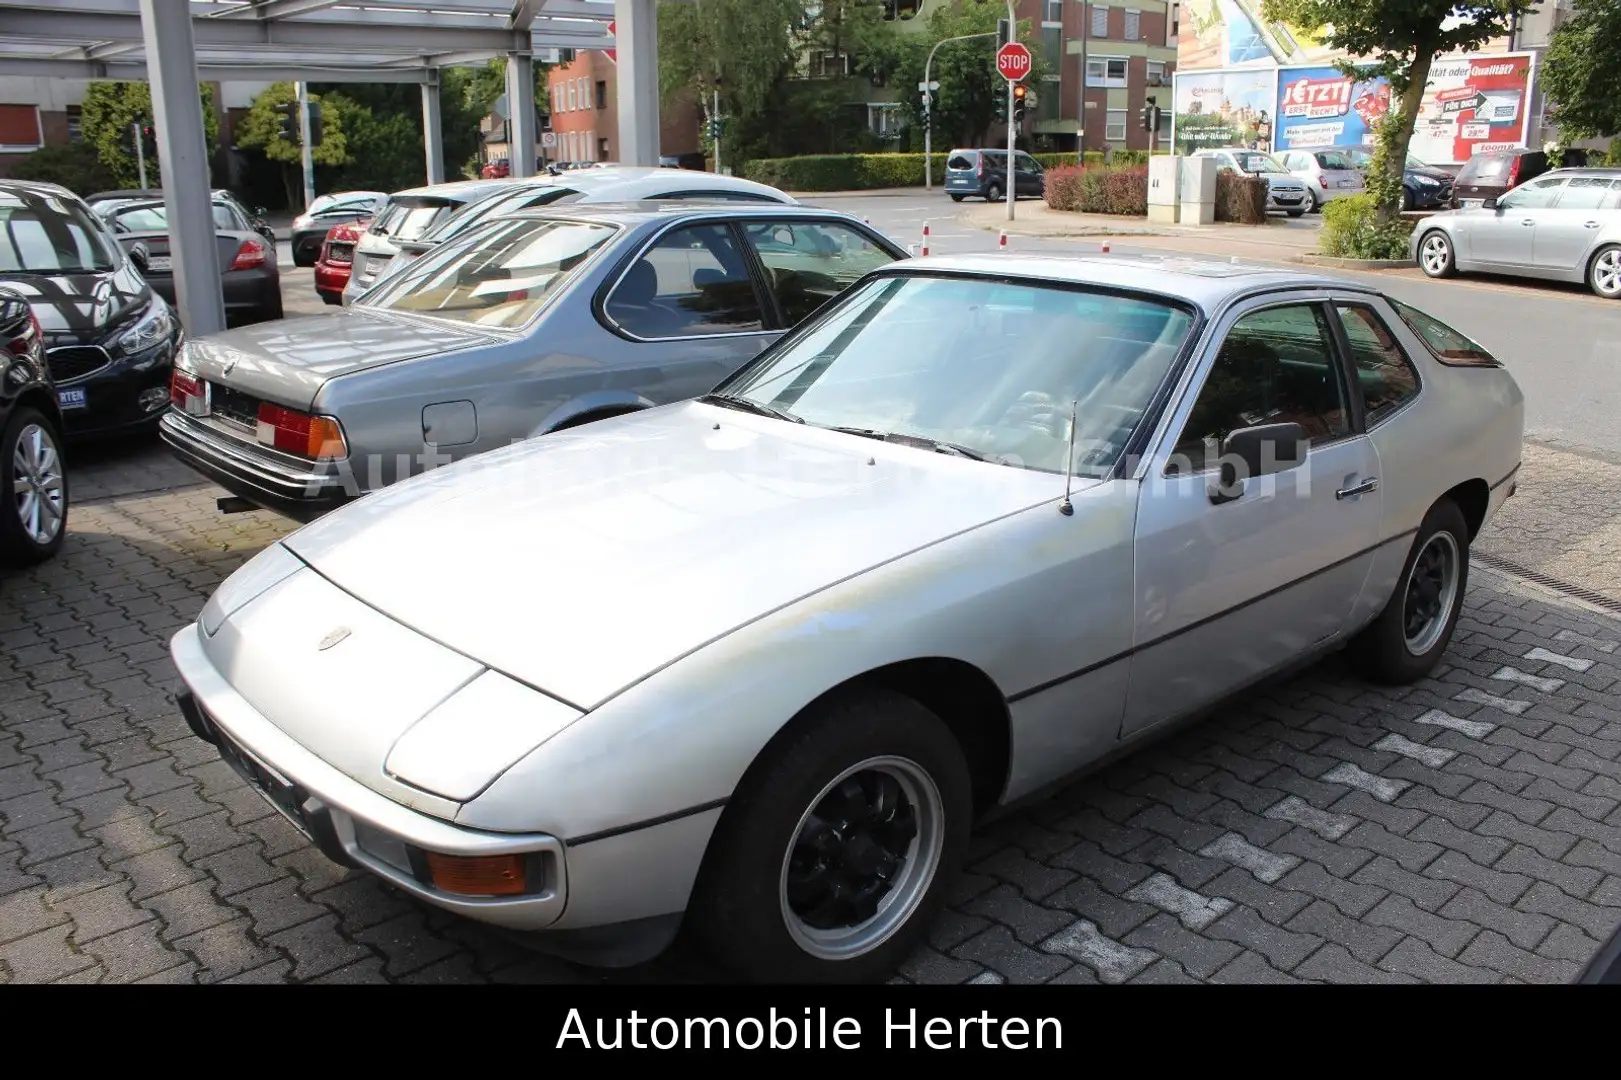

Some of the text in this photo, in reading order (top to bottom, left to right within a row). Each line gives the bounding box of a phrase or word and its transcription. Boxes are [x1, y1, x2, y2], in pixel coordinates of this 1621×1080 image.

[1000, 54, 1028, 69] STOP
[1448, 67, 1469, 77] oder
[1471, 63, 1514, 77] Qualität?
[1460, 98, 1478, 108] DICH
[1288, 106, 1308, 114] ERST
[1310, 107, 1335, 116] RECHT
[58, 390, 84, 403] RTEN
